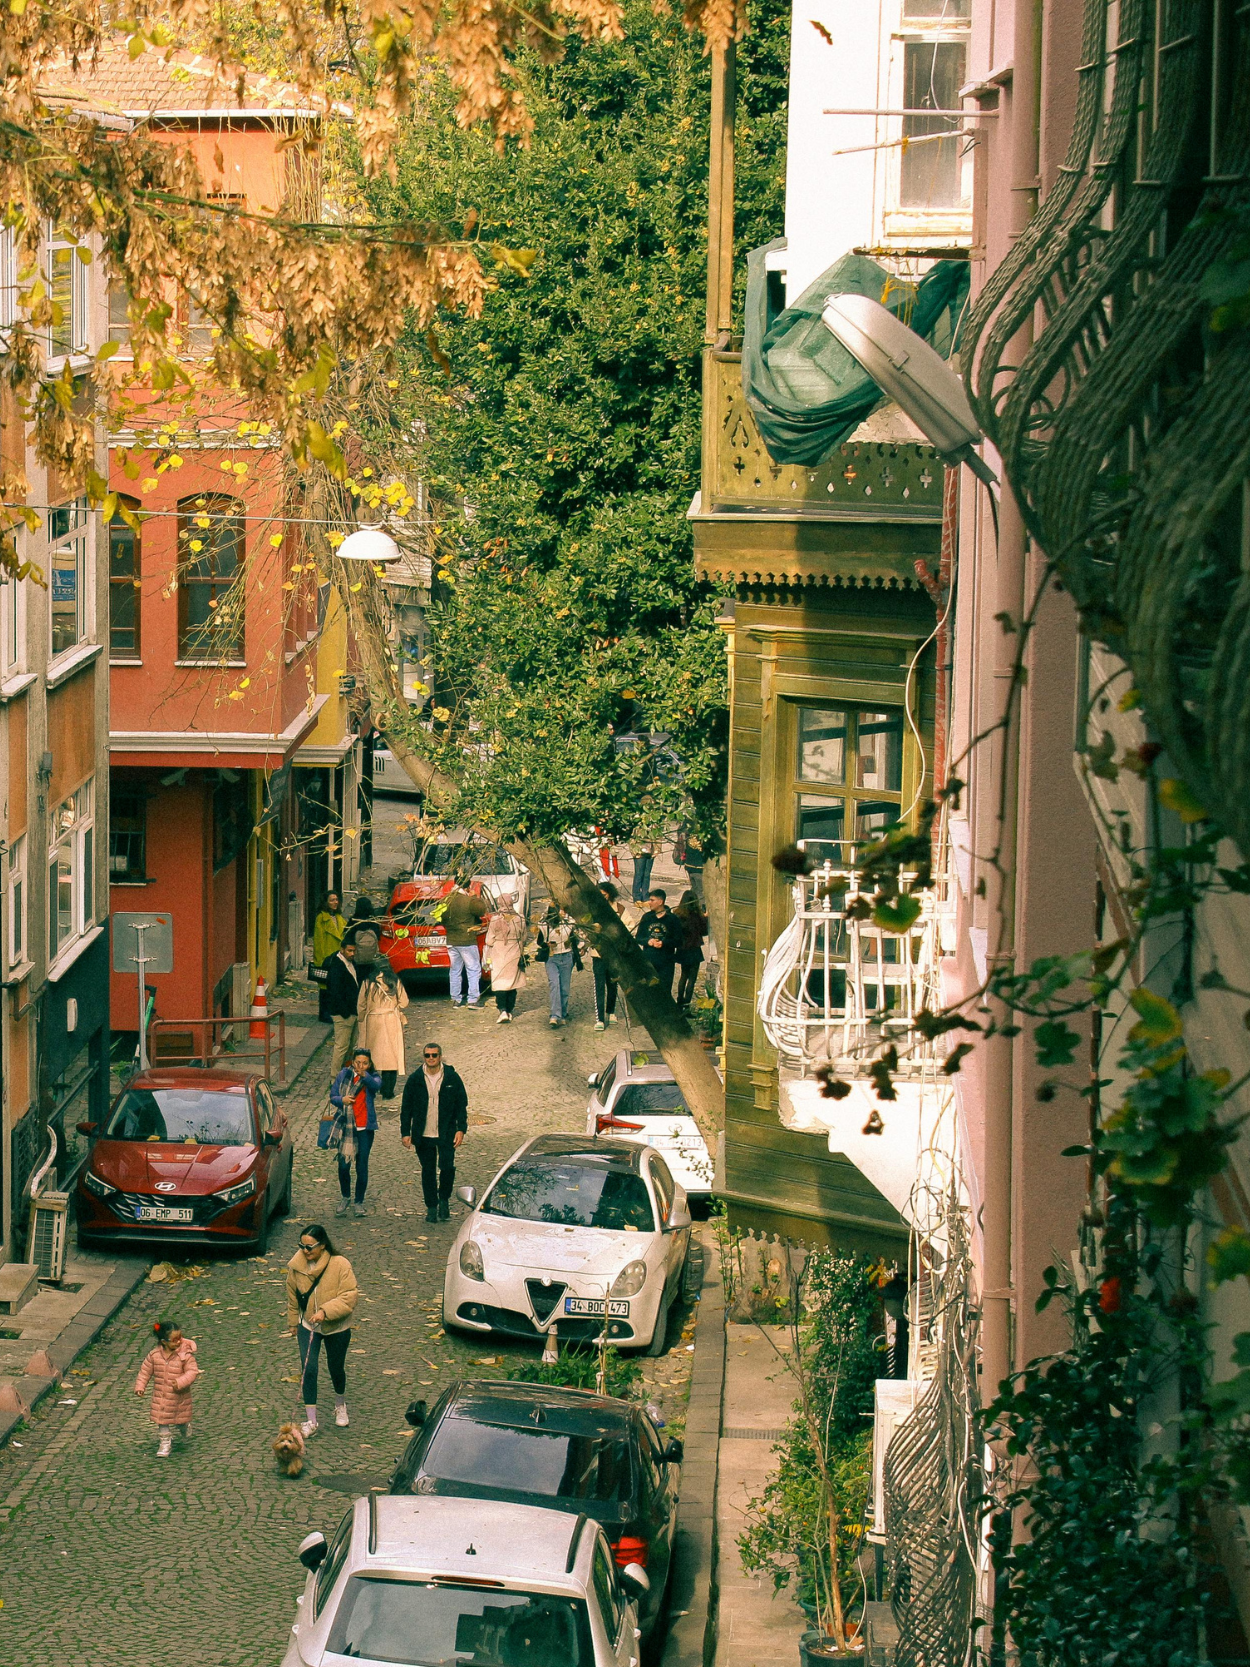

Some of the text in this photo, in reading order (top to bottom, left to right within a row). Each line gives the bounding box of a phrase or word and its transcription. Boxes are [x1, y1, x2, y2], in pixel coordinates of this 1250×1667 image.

[140, 1208, 192, 1219] 06 EMP 511
[571, 1300, 627, 1314] 34 BOC 473
